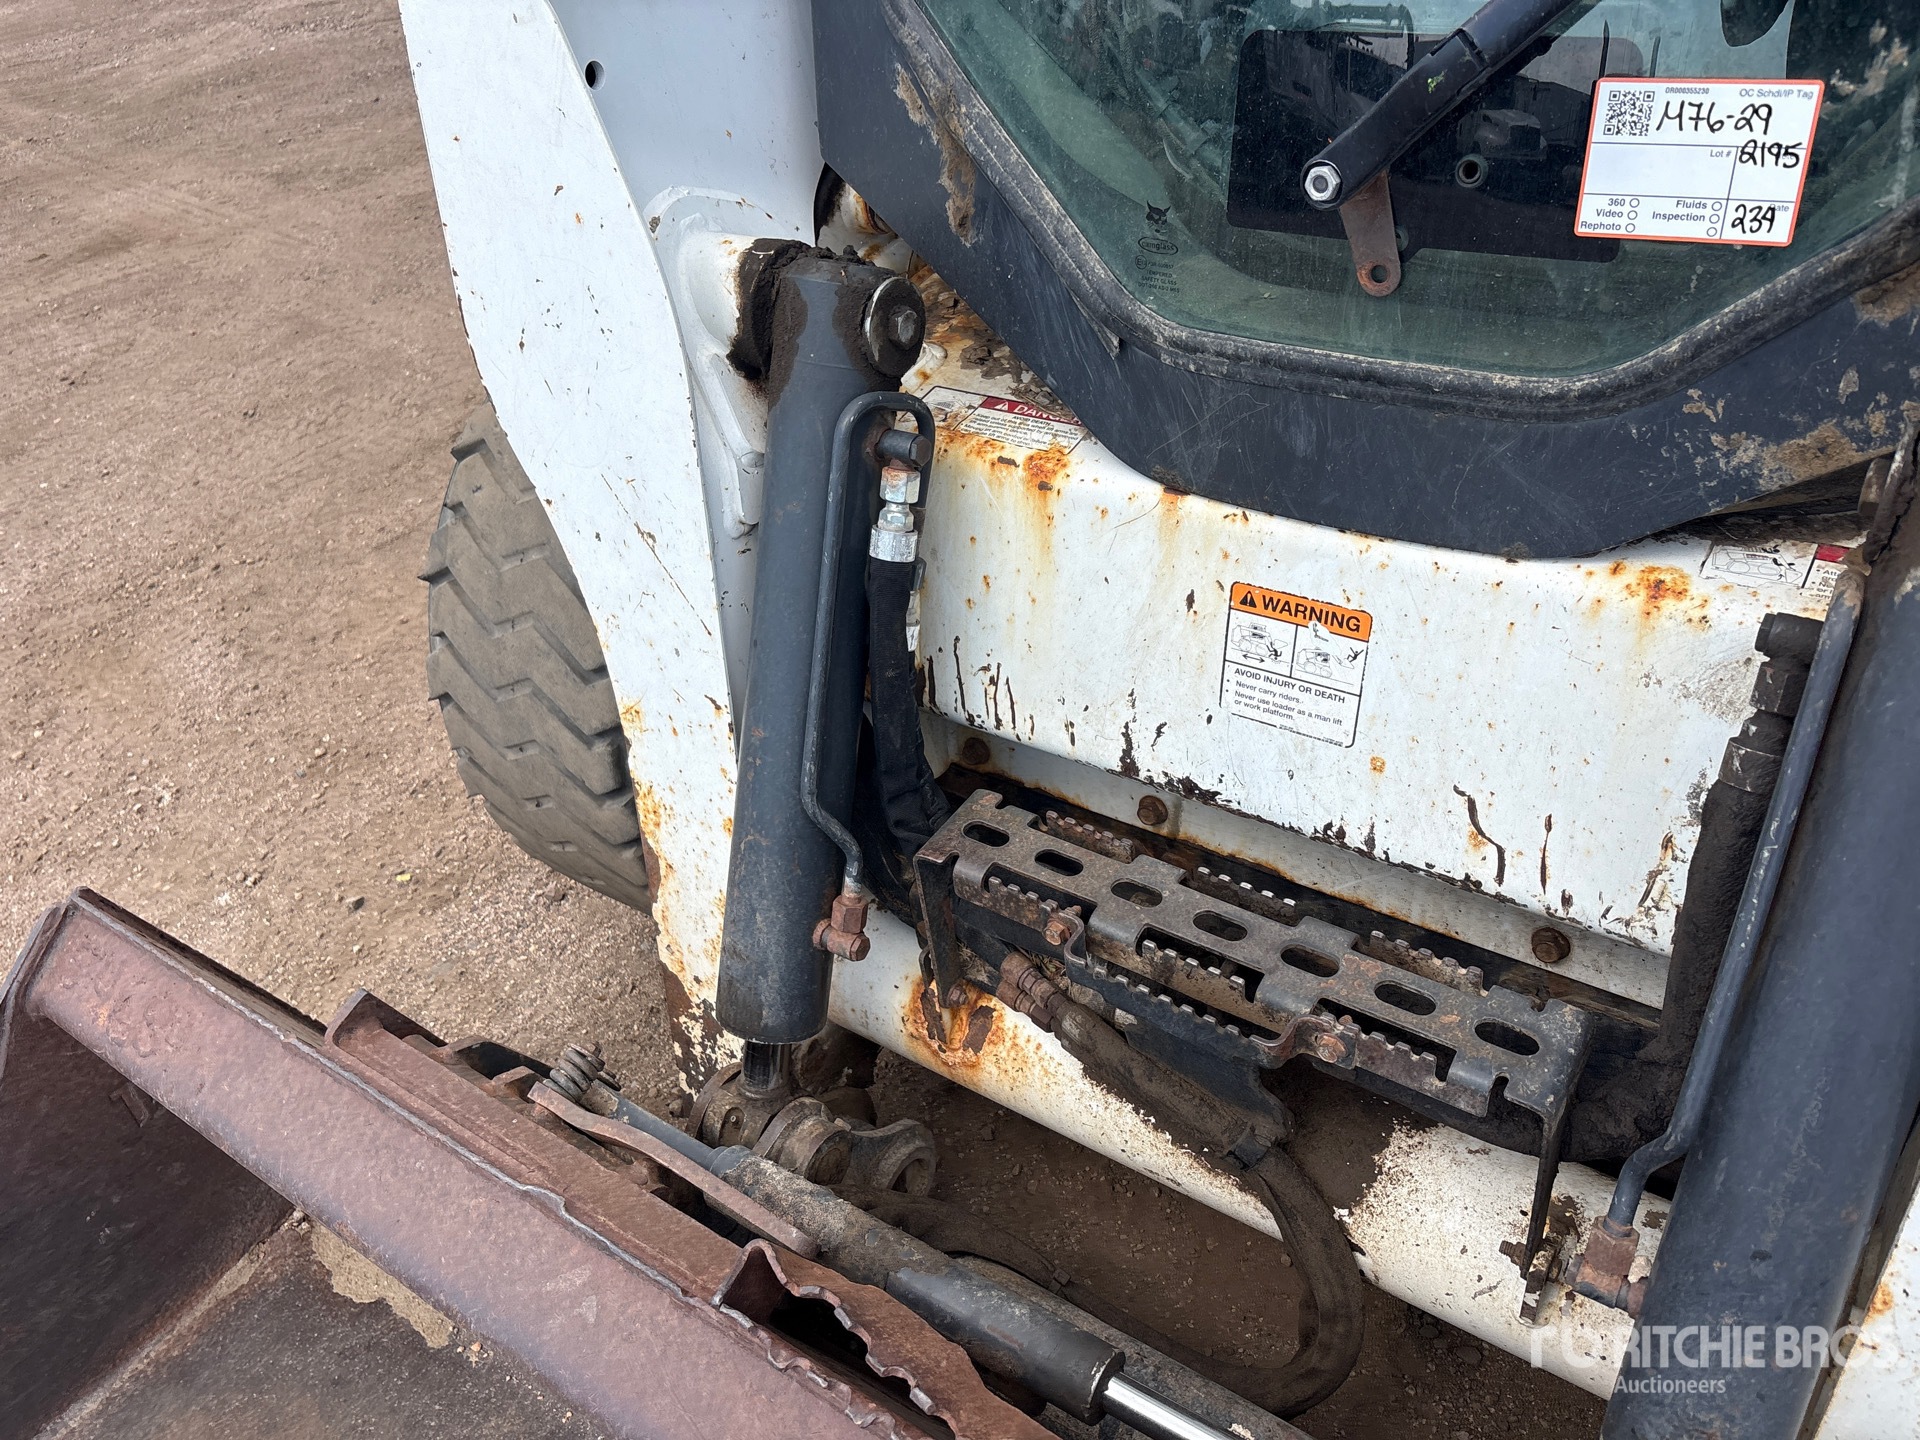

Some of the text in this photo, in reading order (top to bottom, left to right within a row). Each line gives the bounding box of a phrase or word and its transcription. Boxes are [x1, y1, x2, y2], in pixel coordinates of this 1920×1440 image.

[1740, 88, 1755, 97] OC
[1796, 89, 1814, 100] Tag
[1709, 149, 1732, 158] Lot #
[1739, 139, 1803, 168] 2195
[1607, 198, 1626, 207] 360
[1675, 199, 1708, 210] Fluids
[1595, 208, 1624, 218] Video
[1651, 211, 1706, 222] Inspection
[1580, 220, 1622, 231] Rephoto
[1262, 594, 1361, 633] WARNING
[1234, 668, 1346, 704] AVOID INJURY OR DEATH
[1235, 680, 1257, 692] Never
[1258, 687, 1278, 698] carry
[1234, 690, 1257, 702] Never
[1257, 697, 1271, 706] use
[1271, 700, 1296, 712] loader
[1296, 708, 1306, 716] as
[1314, 713, 1331, 723] man
[1332, 717, 1343, 727] lift
[1243, 701, 1261, 711] work
[1262, 707, 1296, 721] platform.
